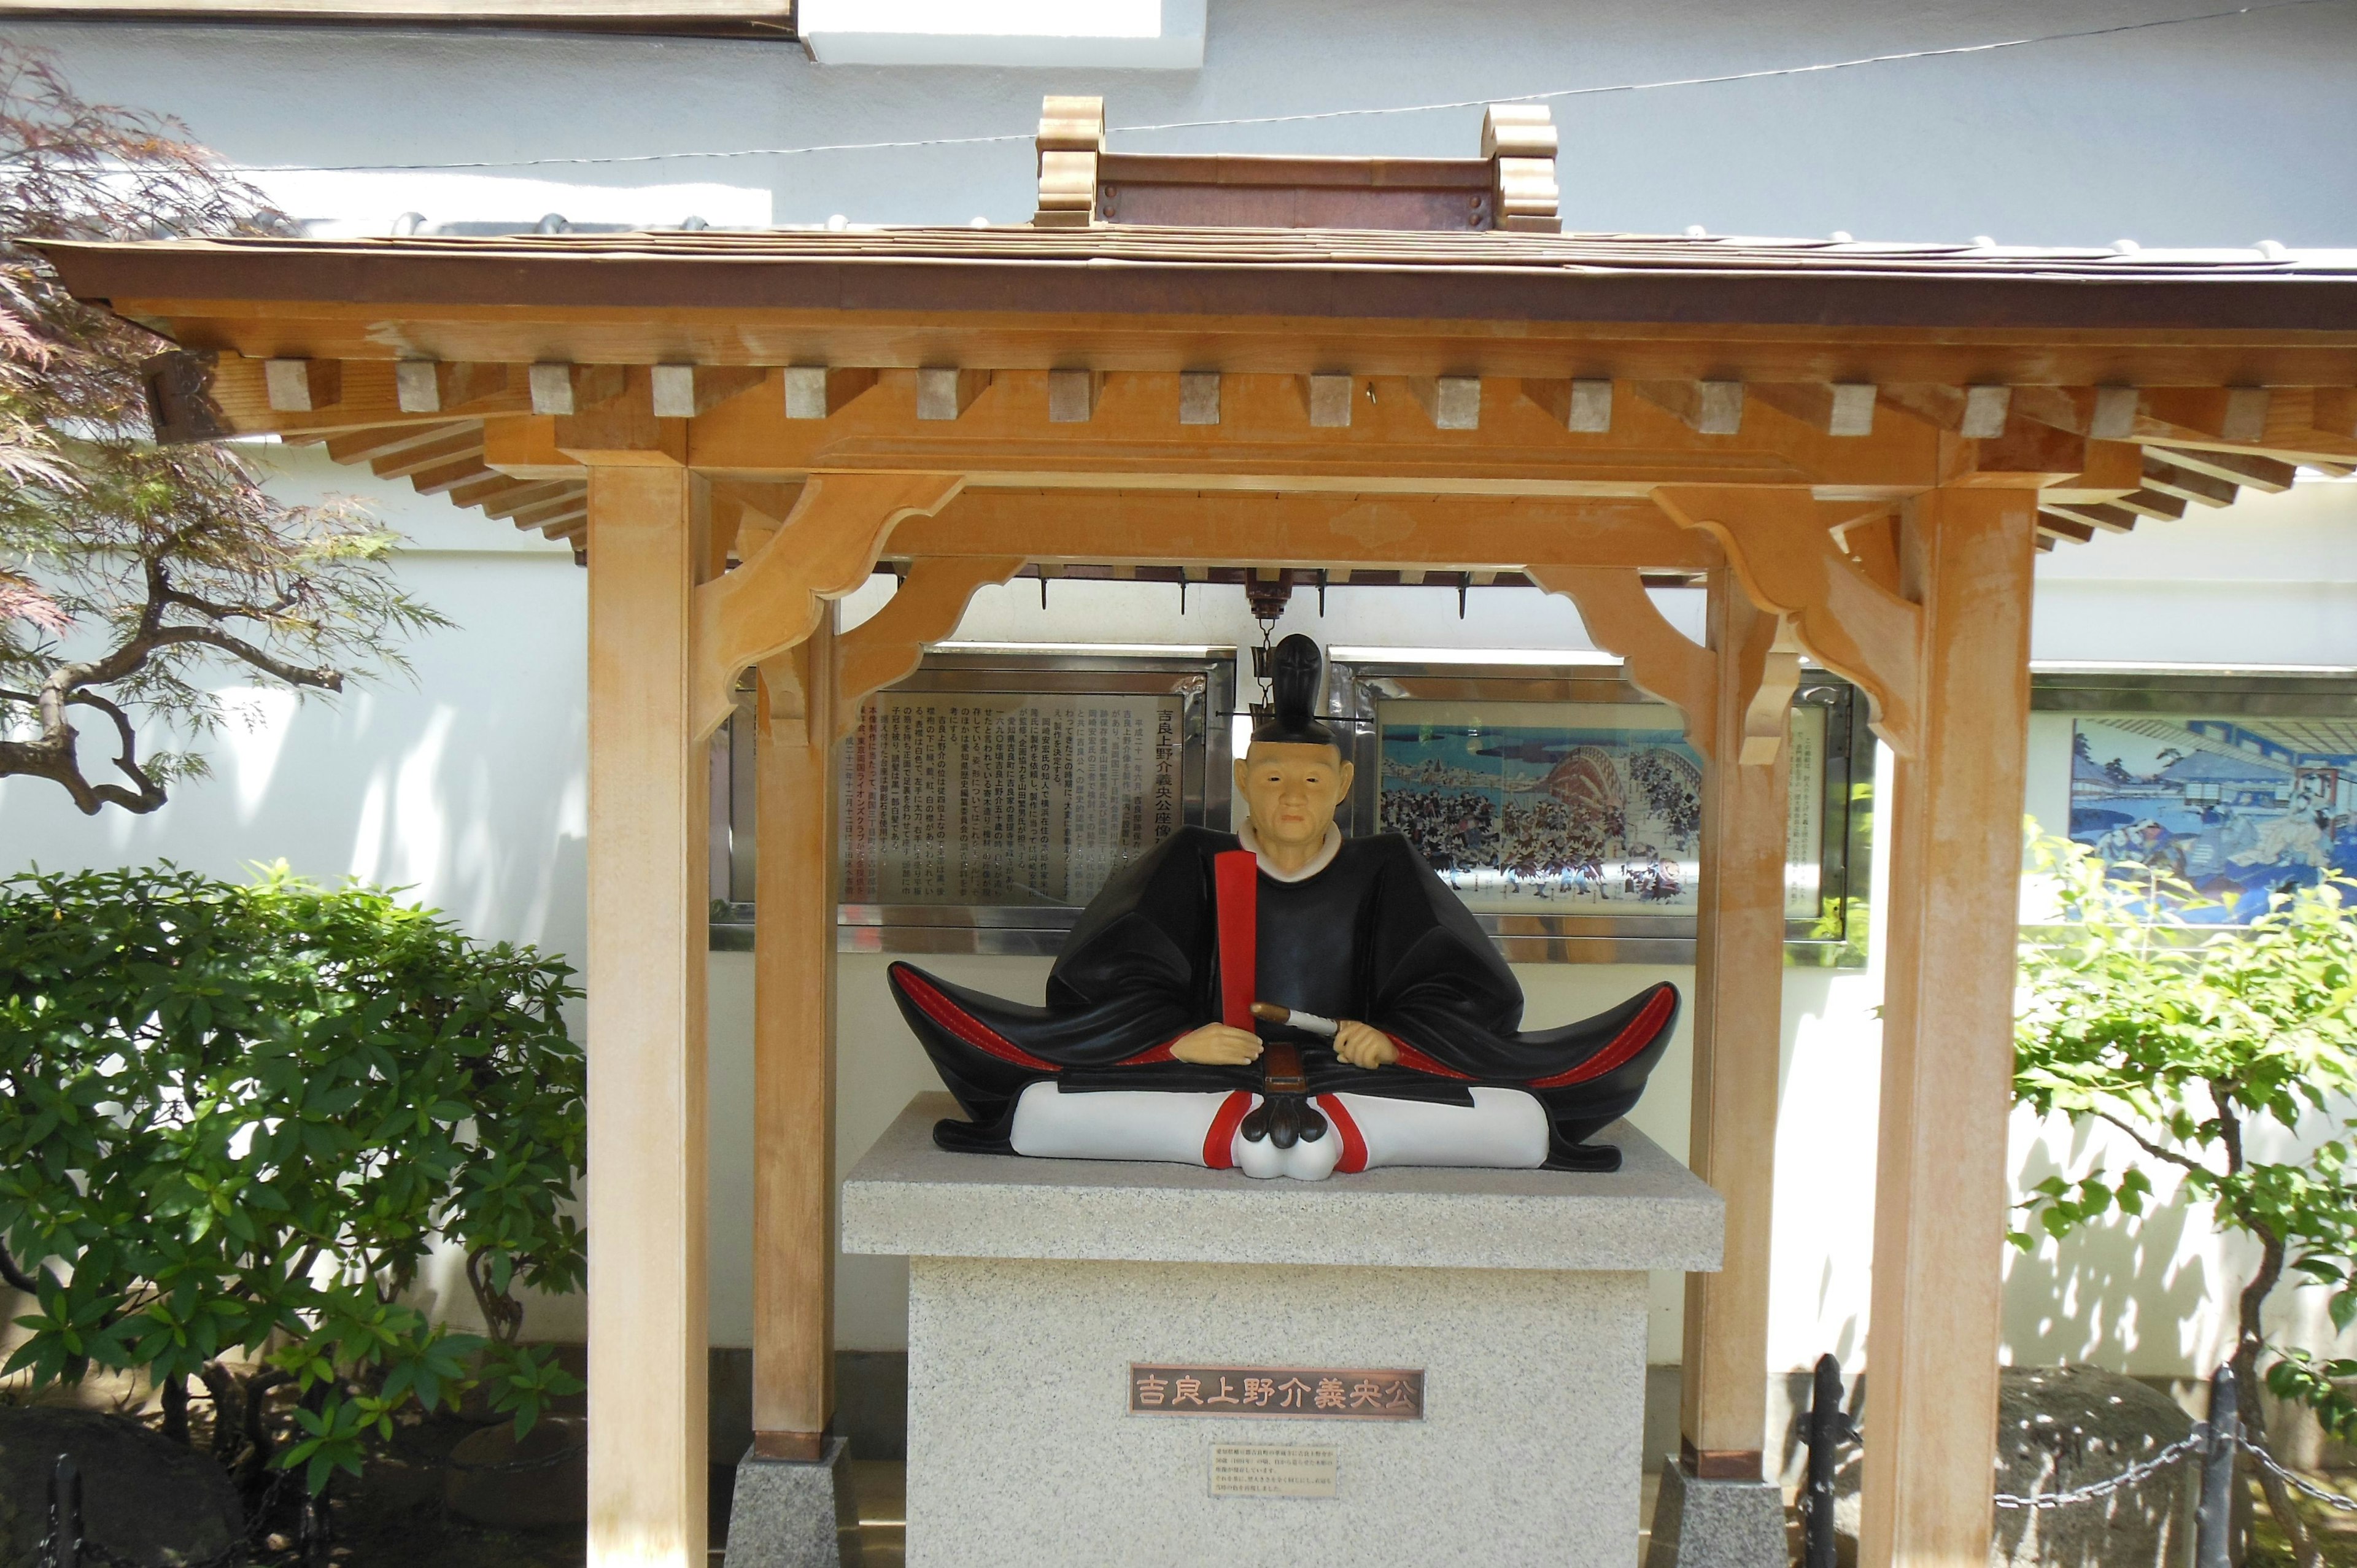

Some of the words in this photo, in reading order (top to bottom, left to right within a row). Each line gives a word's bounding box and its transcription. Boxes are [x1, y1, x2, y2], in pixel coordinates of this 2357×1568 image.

[950, 708, 959, 746] 考にする。
[1053, 709, 1062, 786] え、製作を決定する。
[1155, 709, 1173, 843] 吉良上野介義央公座像
[1136, 1373, 1418, 1410] 吉良上野介義央公
